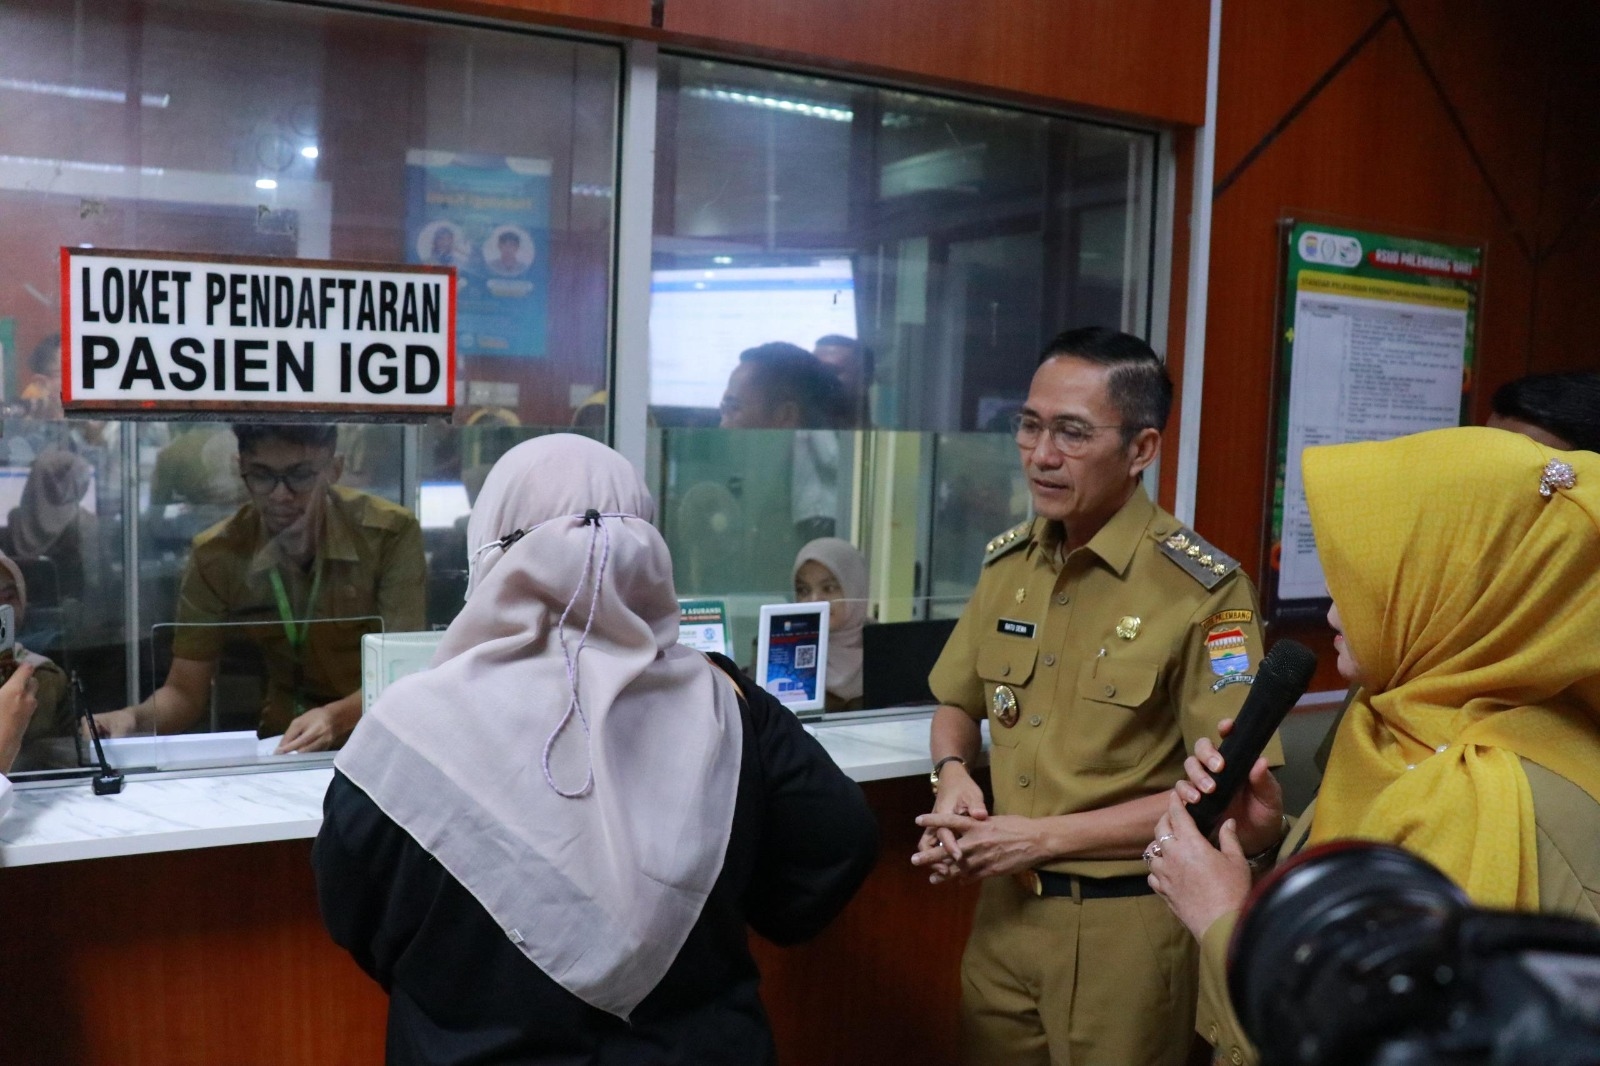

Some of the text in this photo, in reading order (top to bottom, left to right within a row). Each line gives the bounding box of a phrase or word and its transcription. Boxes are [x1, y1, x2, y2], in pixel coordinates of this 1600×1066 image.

[82, 267, 440, 334] LOKET PENDAFTARAN
[82, 335, 440, 394] PASIEN IGD
[688, 607, 722, 615] ASURANSI
[1213, 611, 1250, 622] PALEMBANG
